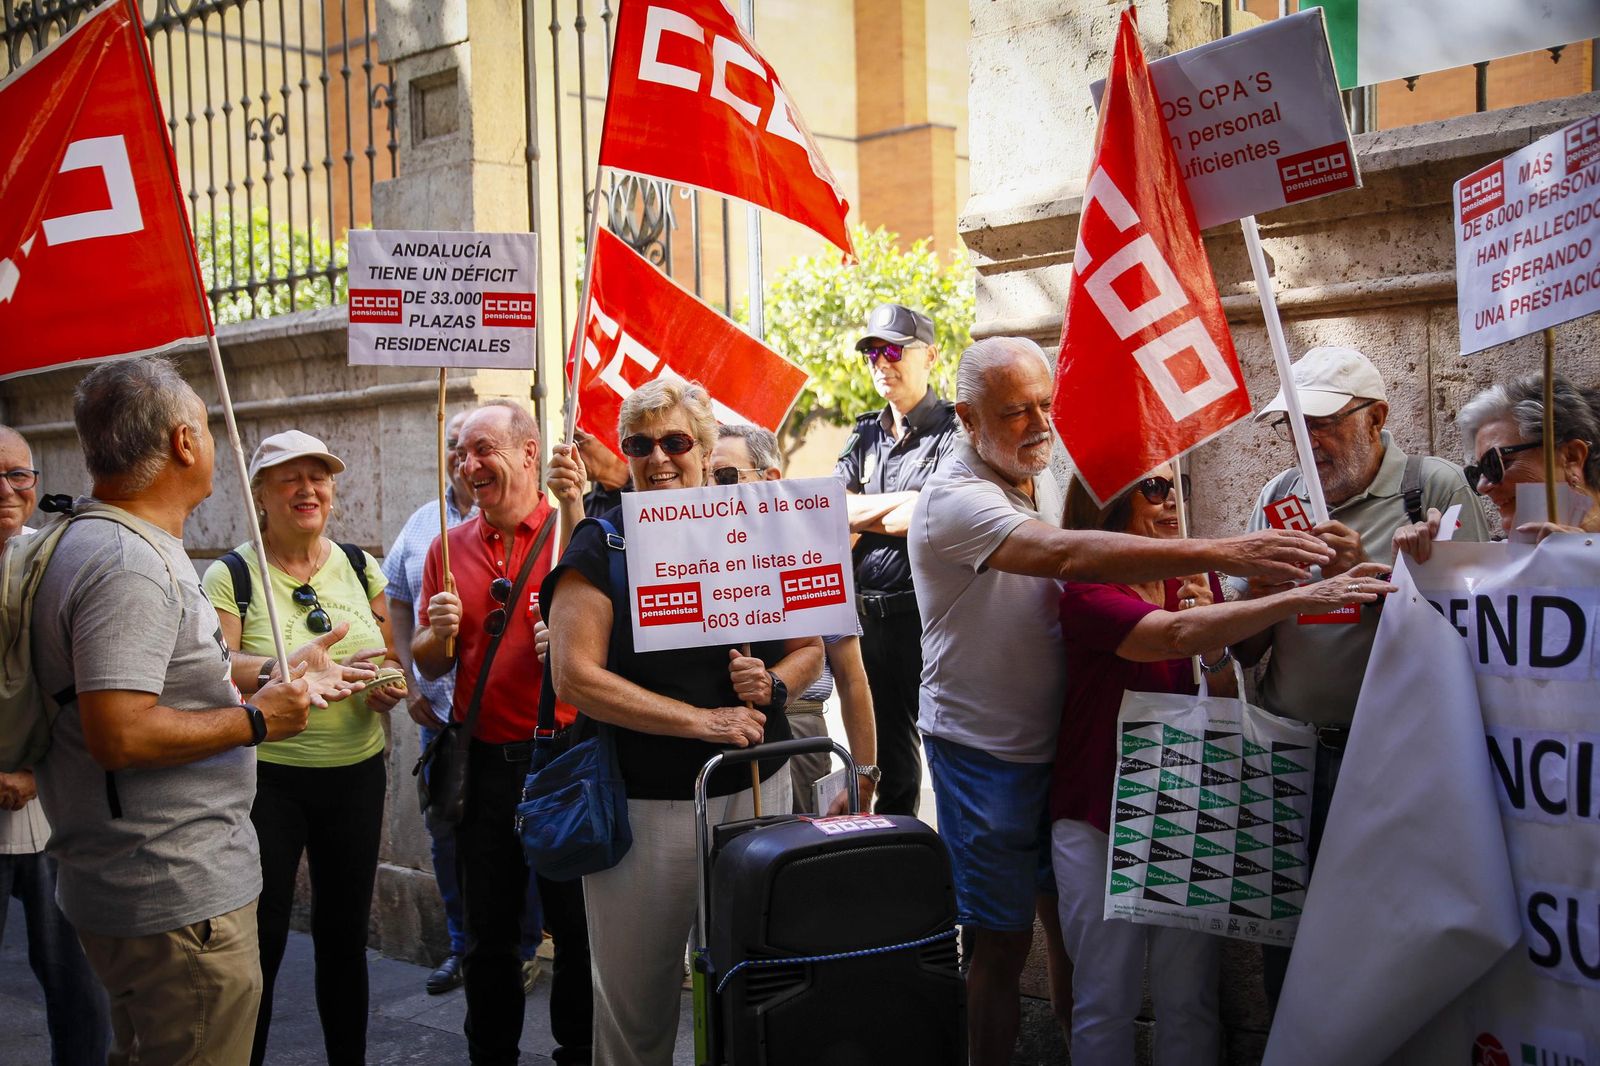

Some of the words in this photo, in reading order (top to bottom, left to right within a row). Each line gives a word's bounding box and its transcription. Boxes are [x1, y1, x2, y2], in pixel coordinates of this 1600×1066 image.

[1188, 101, 1282, 151] personal
[1282, 153, 1346, 181] CCOO
[1518, 152, 1553, 185] MÁS
[1285, 170, 1348, 193] pensionistas
[1461, 171, 1502, 203] CCOO
[1462, 190, 1502, 215] pensionistas
[1463, 217, 1482, 242] DE
[1486, 199, 1523, 231] 8.000
[1528, 166, 1600, 213] PERSON
[392, 241, 491, 258] ANDALUCÍA
[1477, 237, 1508, 267] HAN
[368, 266, 417, 281] TIENE
[422, 267, 447, 281] UN
[451, 264, 518, 282] DÉFICIT
[1491, 238, 1592, 293] ESPERANDO
[351, 296, 399, 308] CCOO
[403, 291, 426, 304] DE
[430, 291, 482, 305] 33.000
[484, 299, 532, 312] CCOO
[351, 309, 399, 317] pensionistas
[409, 314, 476, 329] PLAZAS
[484, 312, 532, 321] pensionistas
[1475, 303, 1505, 331] UNA
[374, 336, 511, 353] RESIDENCIALES
[638, 497, 747, 524] ANDALUCÍA
[758, 502, 769, 514] a
[774, 497, 789, 512] la
[794, 495, 830, 510] cola
[726, 529, 747, 544] de
[655, 560, 720, 579] España
[725, 559, 746, 573] en
[752, 554, 797, 570] listas
[802, 550, 822, 565] de
[712, 583, 771, 603] espera
[783, 573, 840, 593] CCOO
[640, 591, 697, 609] CCOO
[785, 589, 841, 603] pensionistas
[641, 607, 698, 619] pensionistas
[702, 613, 739, 633] ¡603
[745, 608, 786, 627] días!
